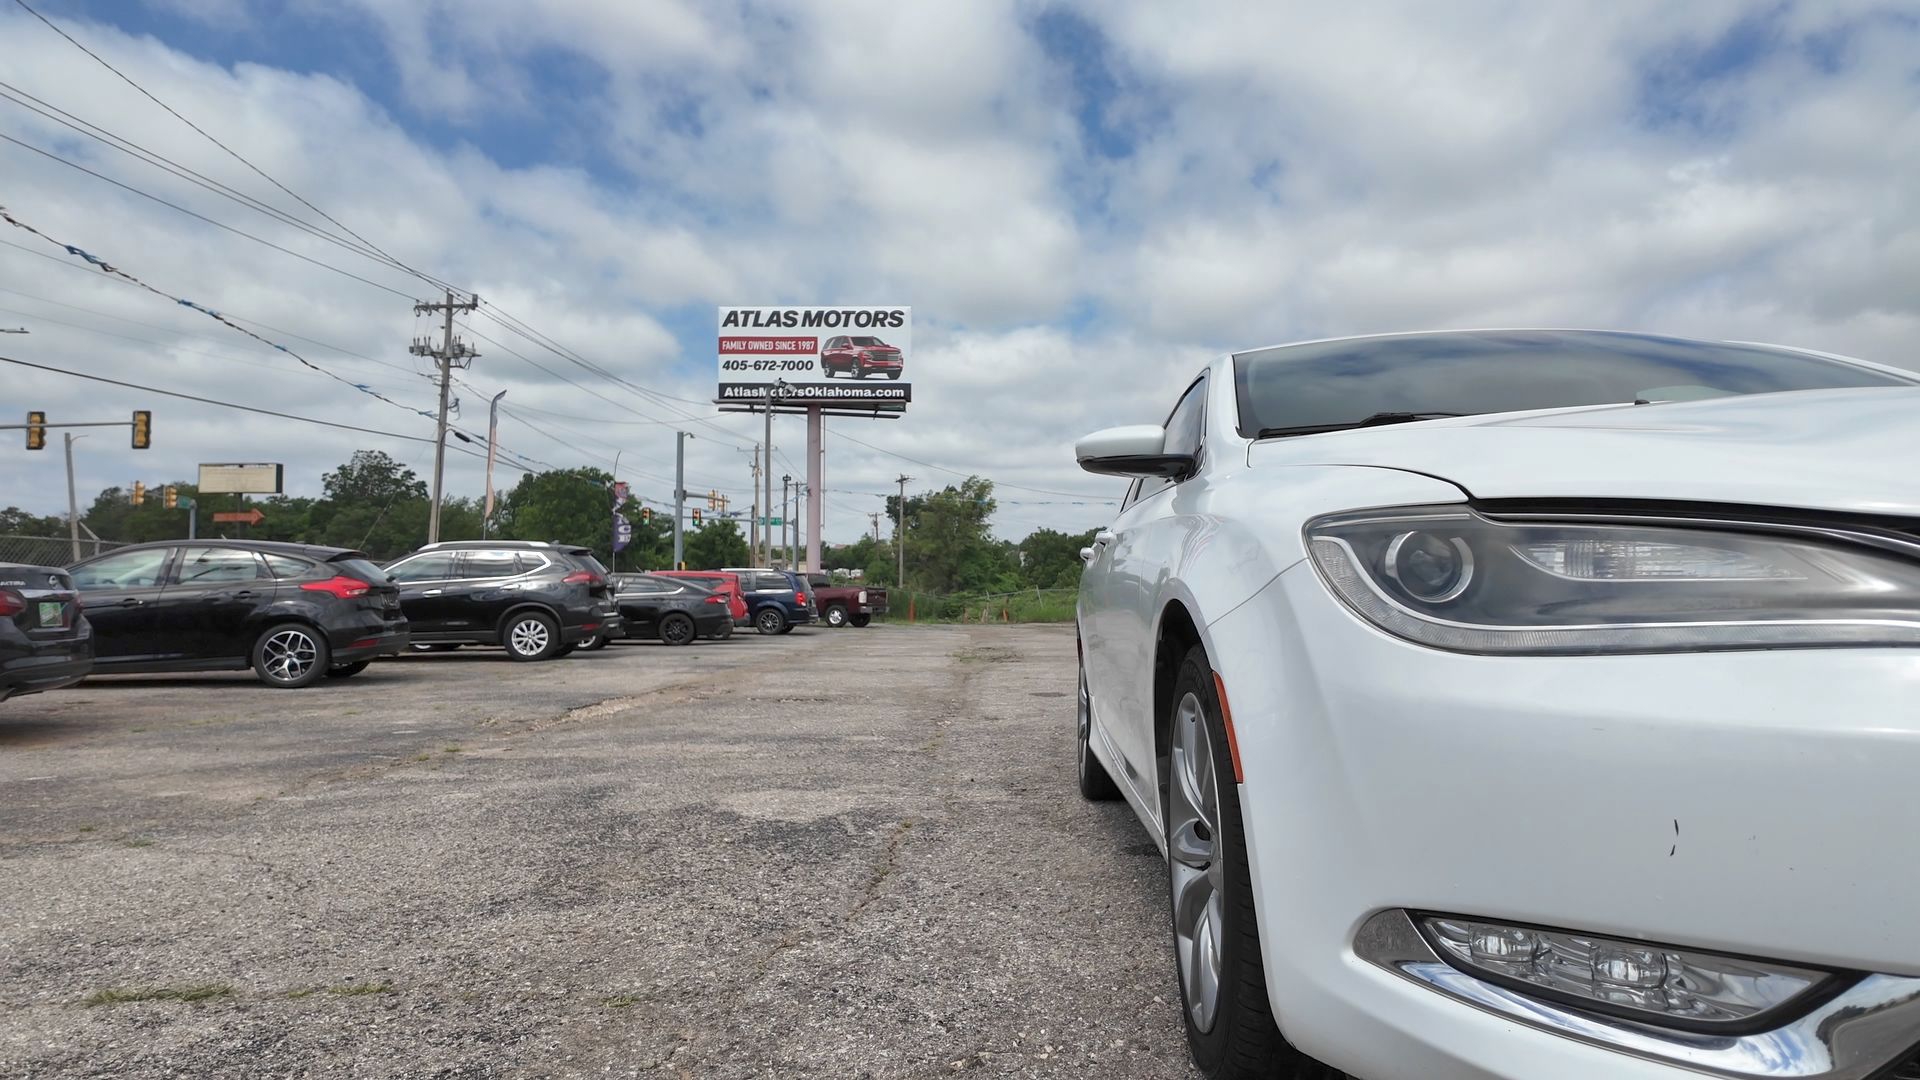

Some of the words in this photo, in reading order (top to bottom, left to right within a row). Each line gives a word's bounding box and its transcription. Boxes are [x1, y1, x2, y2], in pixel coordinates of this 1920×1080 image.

[722, 310, 799, 328] ATLAS
[801, 310, 905, 328] MOTORS
[722, 341, 747, 351] FAMILY
[748, 341, 774, 351] OWNED
[775, 340, 797, 351] SINCE
[798, 340, 815, 350] 1987
[722, 360, 814, 371] 405-672-7000
